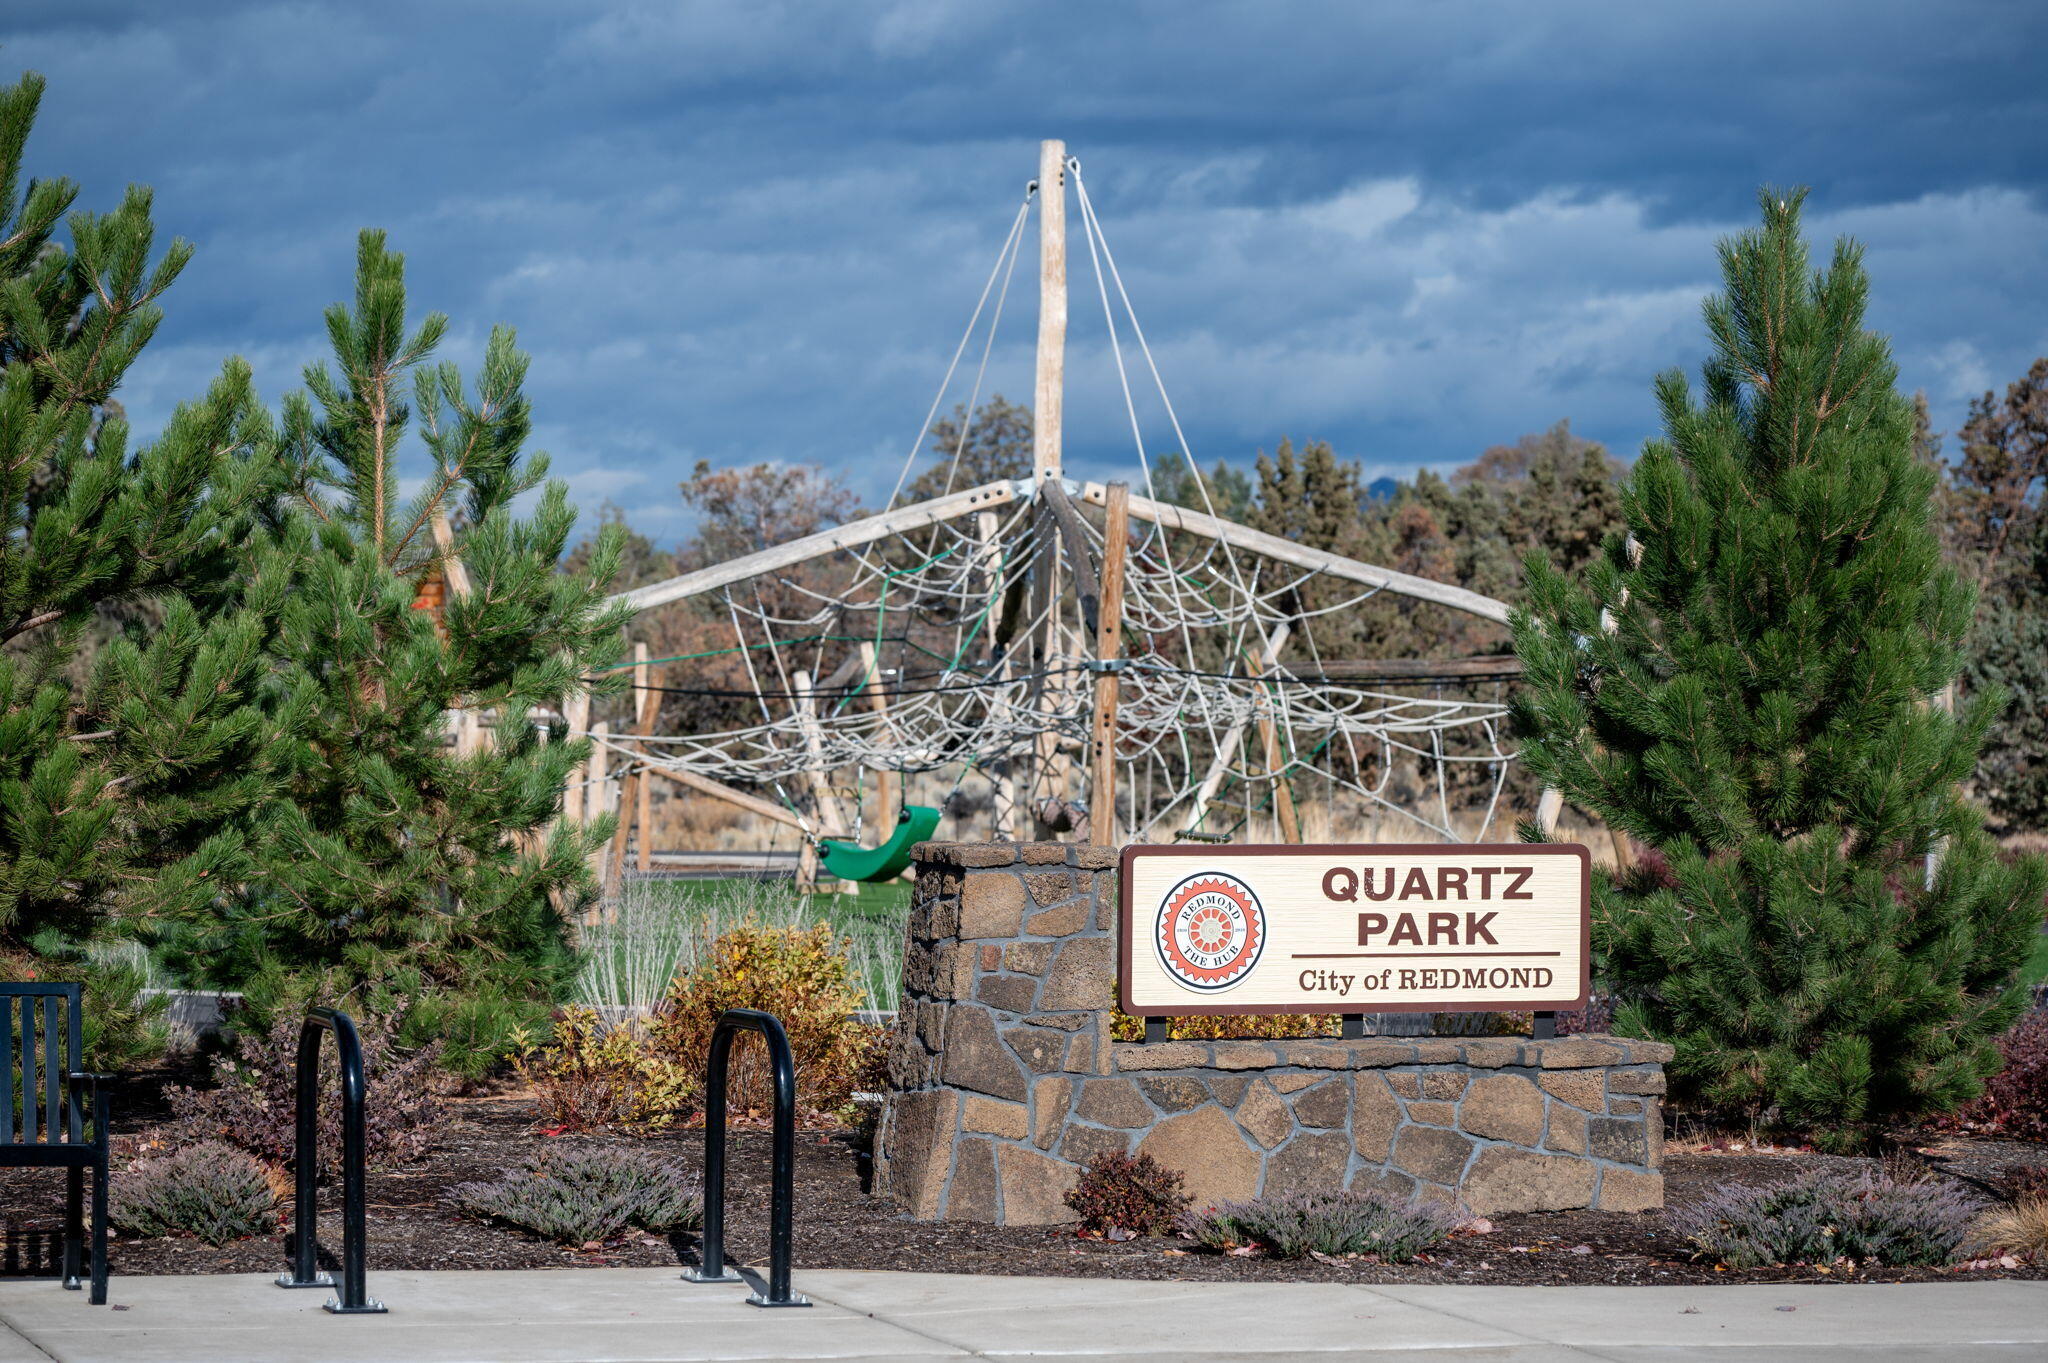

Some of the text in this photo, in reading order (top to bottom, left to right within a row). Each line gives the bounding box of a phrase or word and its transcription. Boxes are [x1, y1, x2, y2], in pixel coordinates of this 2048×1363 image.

[1321, 866, 1534, 903] QUARTZ
[1181, 895, 1241, 921] REDMOND
[1357, 911, 1500, 947] PARK
[1183, 945, 1239, 967] THE HUB
[1298, 967, 1553, 997] City of REDMOND
